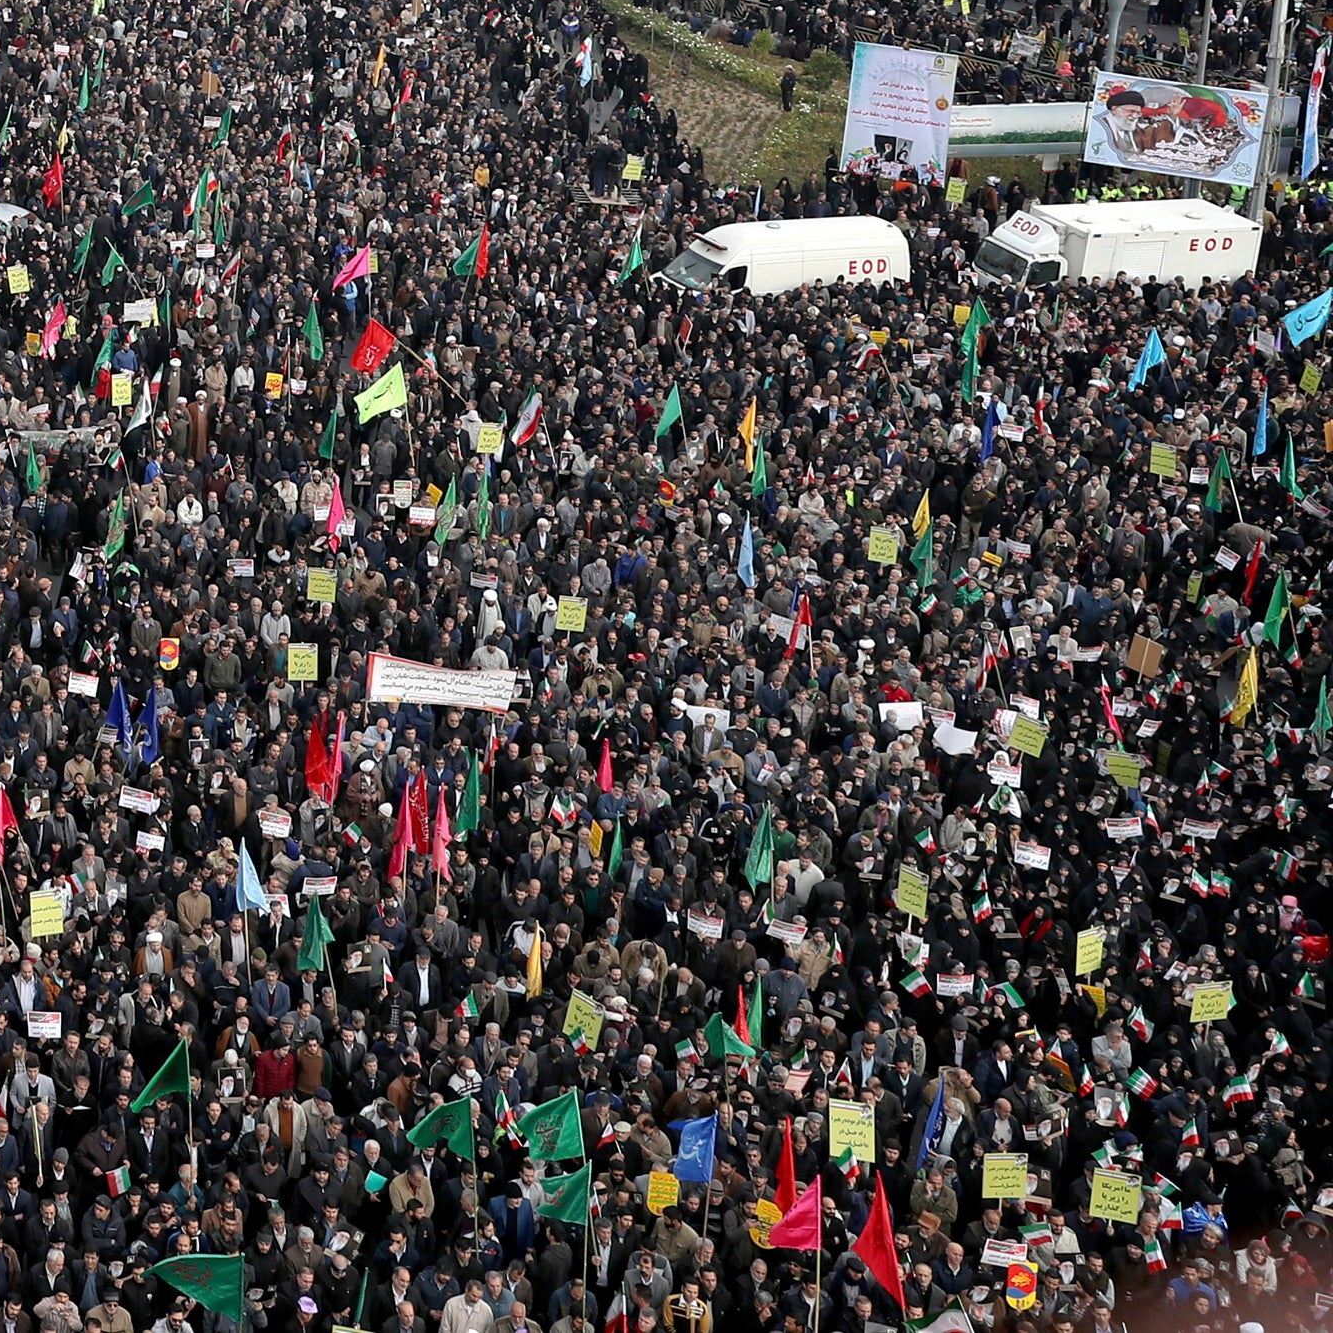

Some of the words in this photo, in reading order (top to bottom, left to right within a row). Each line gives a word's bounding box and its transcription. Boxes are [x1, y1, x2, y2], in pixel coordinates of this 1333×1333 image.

[1011, 216, 1040, 236] EOD
[1189, 237, 1233, 252] EOD
[848, 259, 887, 275] EOD
